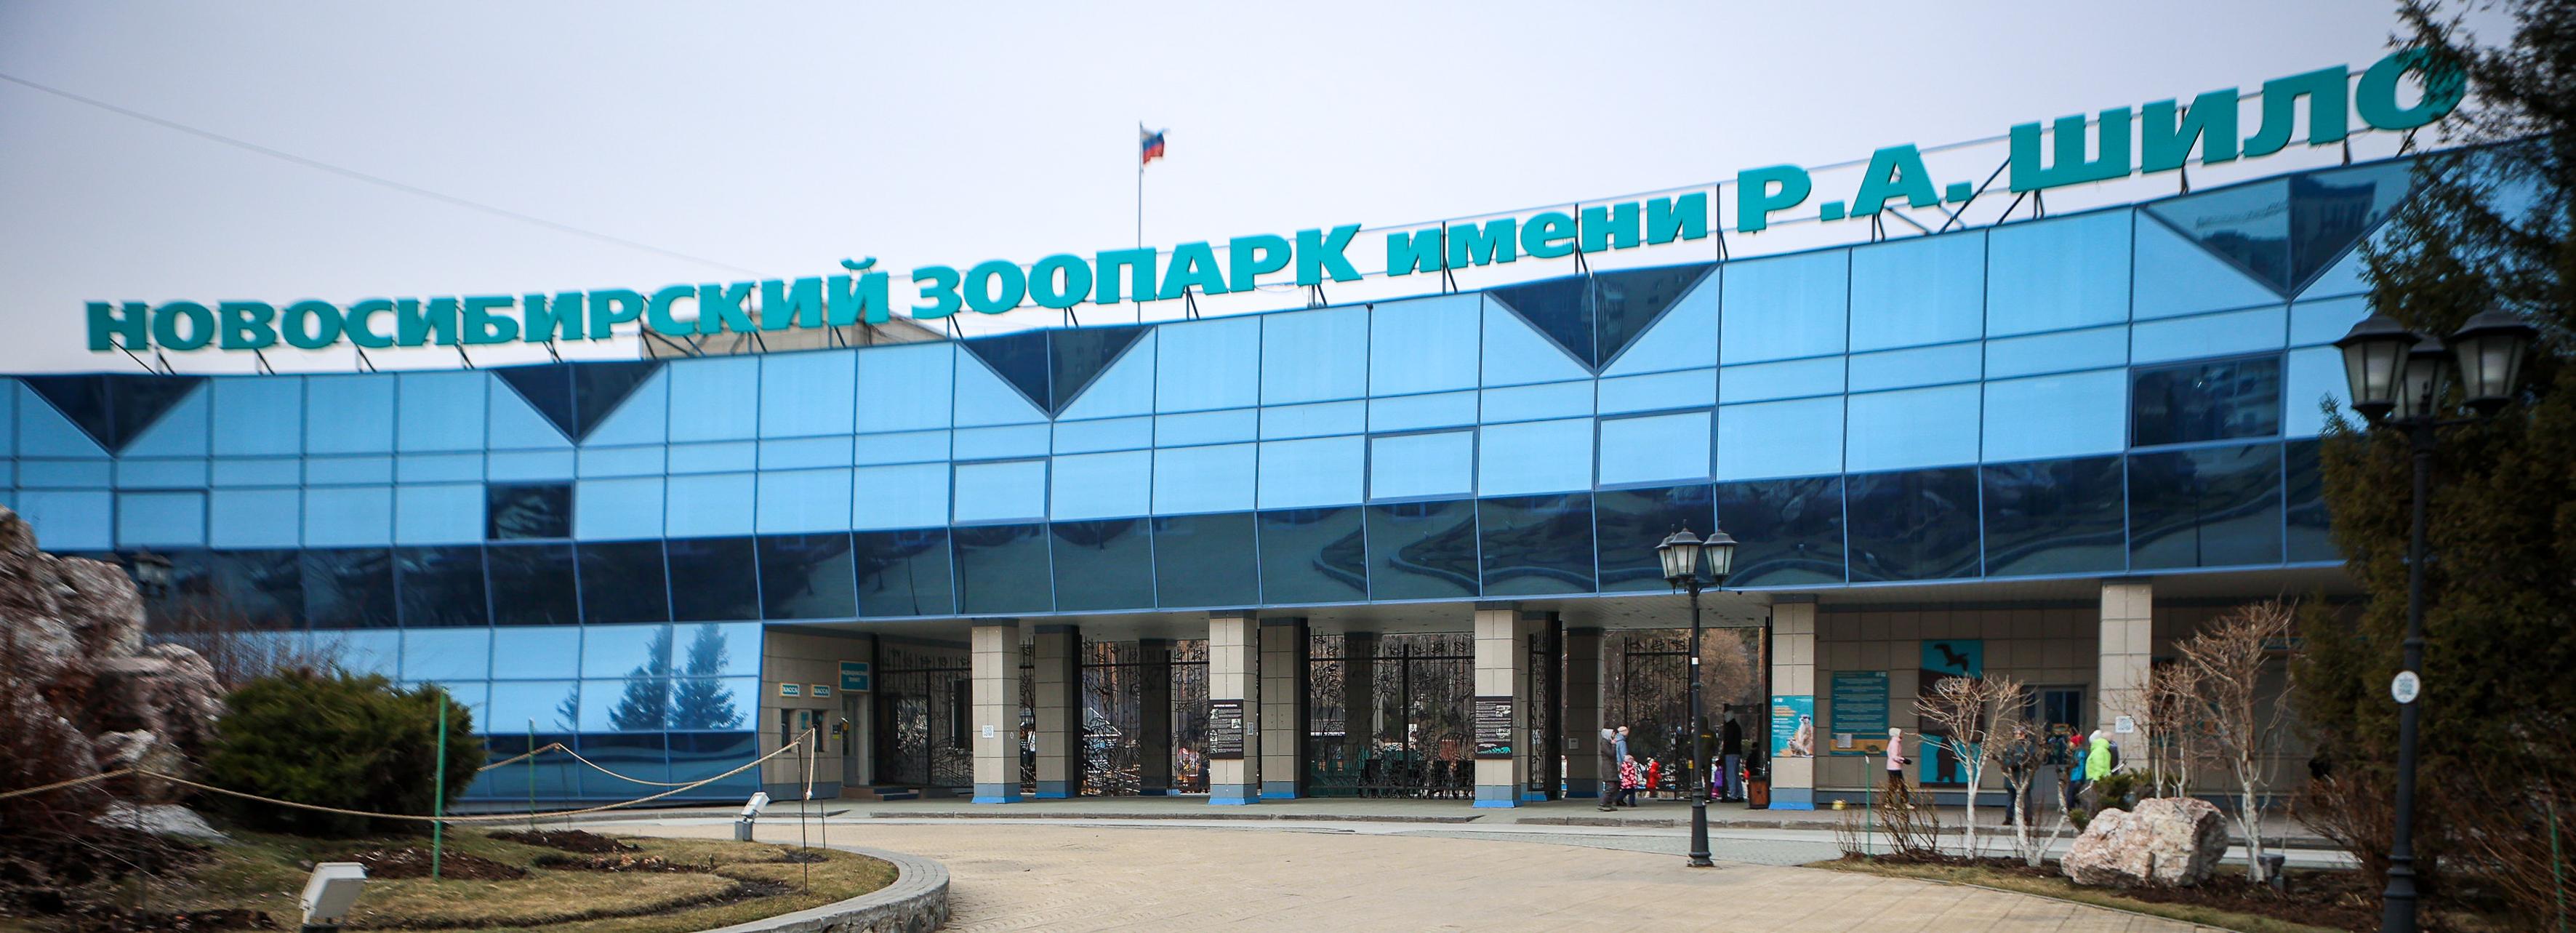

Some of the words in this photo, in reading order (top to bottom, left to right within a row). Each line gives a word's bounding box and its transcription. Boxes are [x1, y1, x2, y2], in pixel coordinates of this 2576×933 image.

[86, 257, 891, 351] НОВОСИБИРСКИЙ
[912, 224, 1362, 319] ЗООПАРК
[1387, 193, 1707, 276] имени
[2010, 46, 2467, 195] ШИЛО
